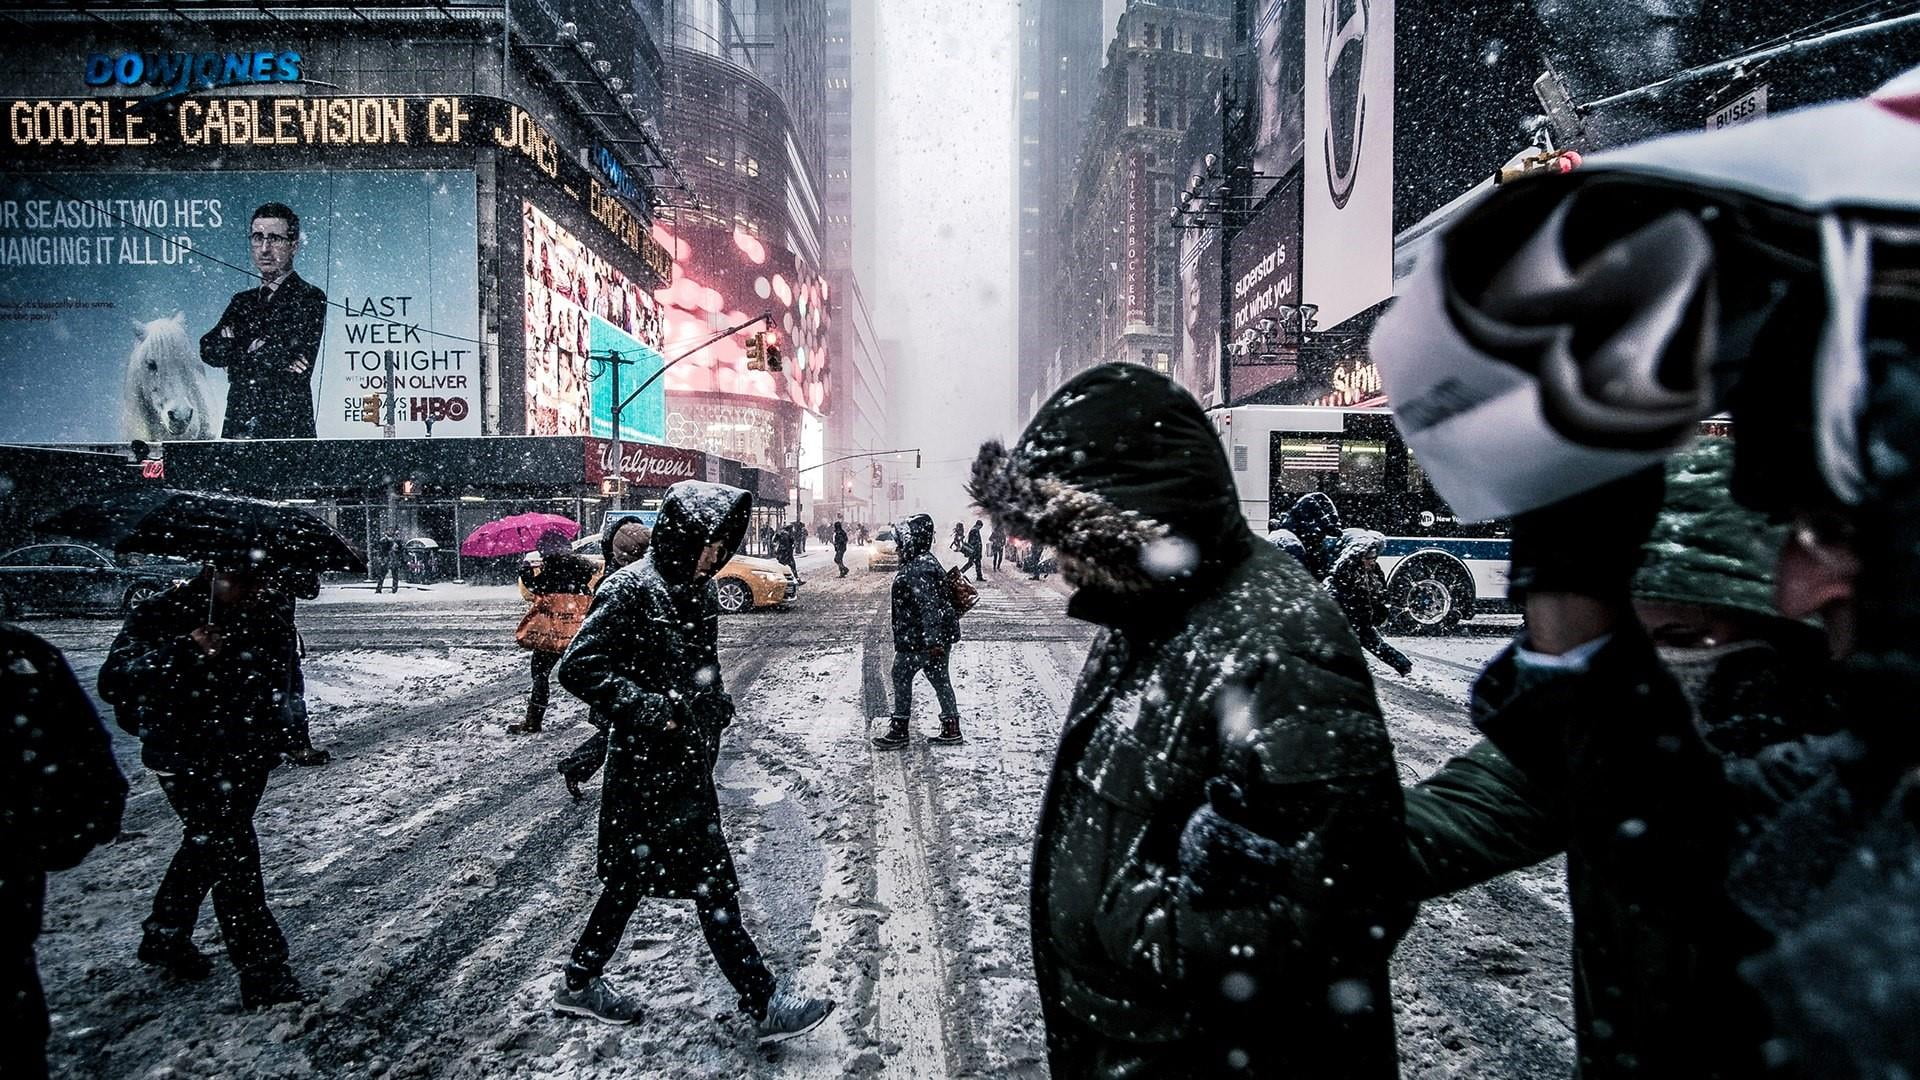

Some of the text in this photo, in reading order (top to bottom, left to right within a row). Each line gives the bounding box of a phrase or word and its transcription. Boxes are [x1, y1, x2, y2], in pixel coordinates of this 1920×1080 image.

[179, 98, 405, 145] CABLEVISION
[1716, 97, 1756, 130] BUSES
[494, 105, 558, 179] JONES
[25, 199, 112, 229] SEASON
[113, 199, 168, 228] TWO
[174, 198, 223, 228] HE'S
[1128, 156, 1137, 307] KNICKERBOCKER
[97, 236, 114, 265] IT
[118, 236, 158, 265] ALL
[162, 235, 194, 265] UP.
[1234, 241, 1286, 299] superstar is
[345, 296, 412, 317] LAST
[1234, 272, 1292, 330] not what you
[345, 323, 421, 344] WEEK
[344, 350, 466, 371] TONIGHT
[409, 375, 467, 390] OLIVER
[409, 396, 469, 421] HBO
[598, 442, 696, 483] Walgreens
